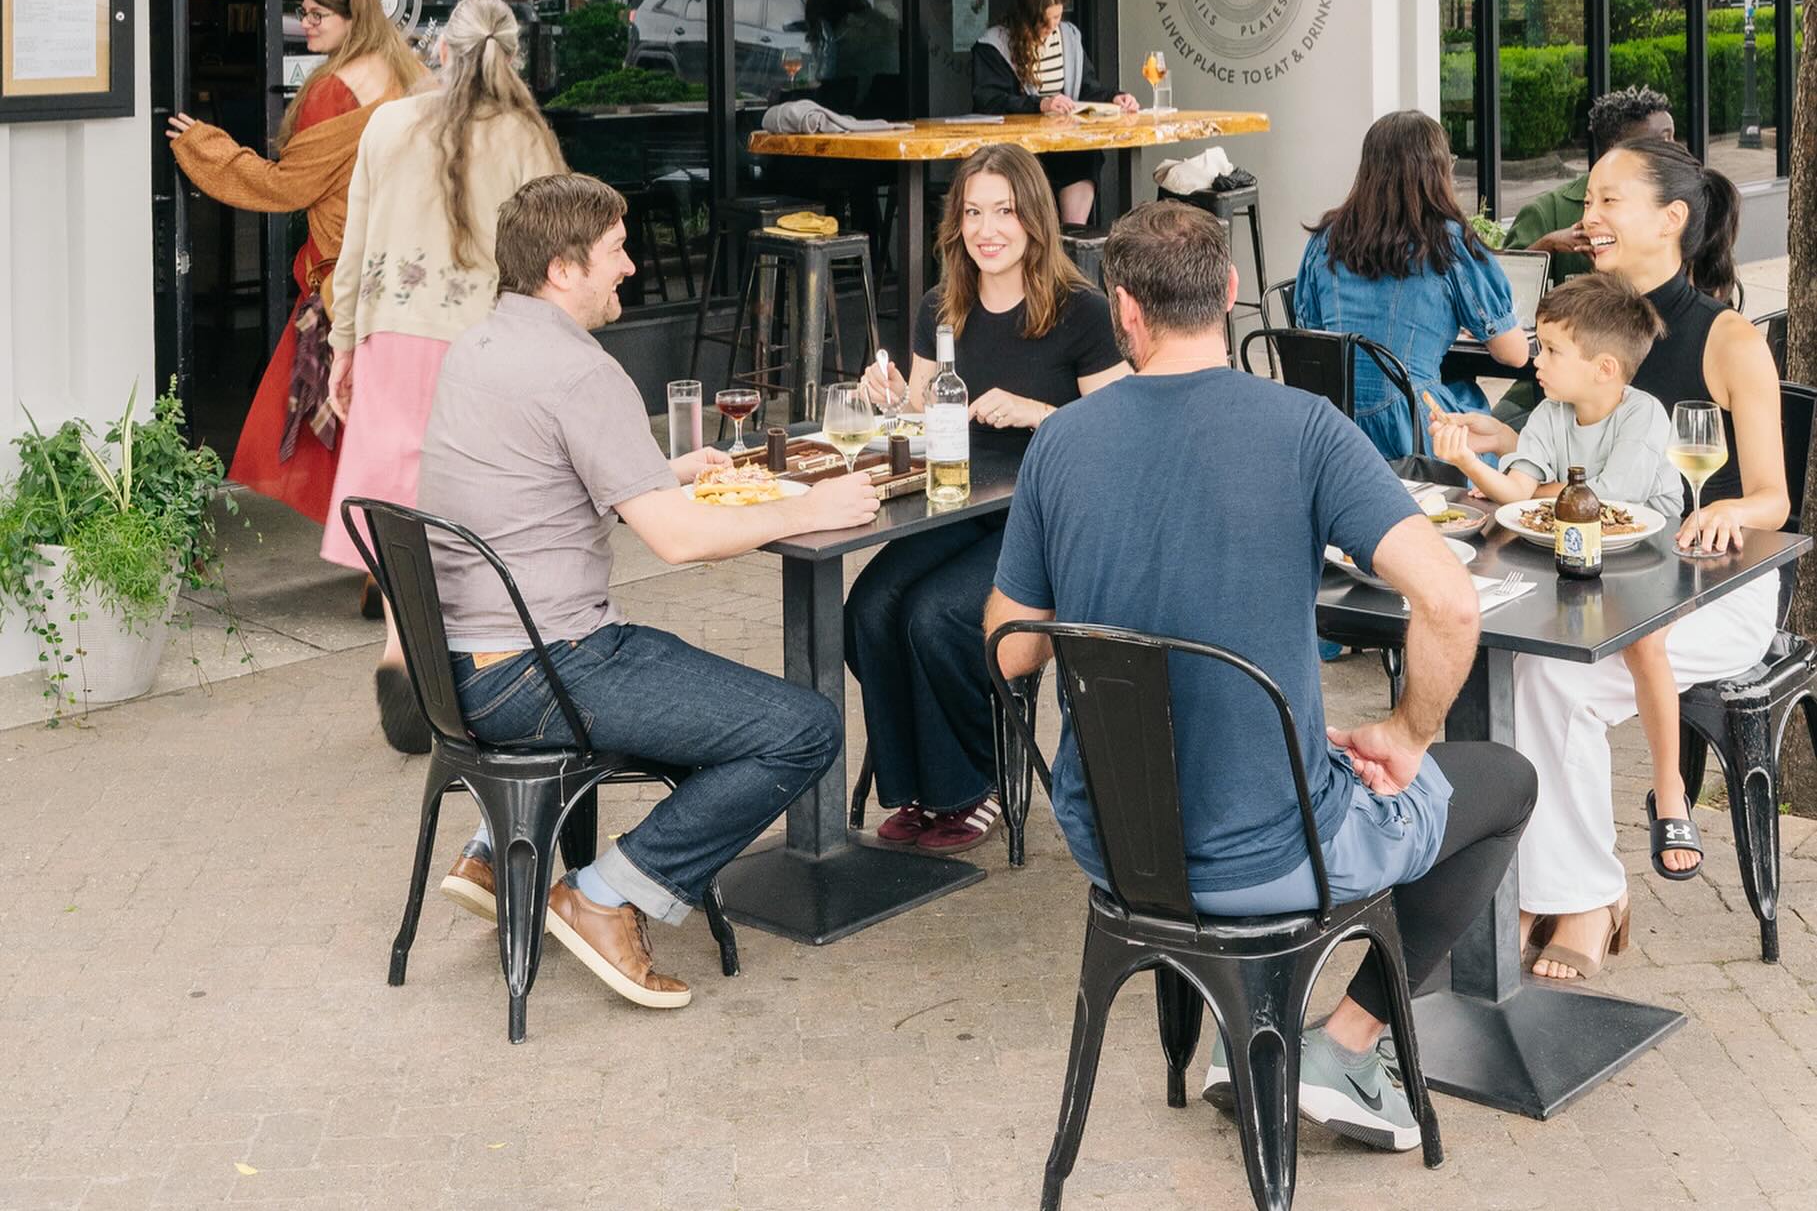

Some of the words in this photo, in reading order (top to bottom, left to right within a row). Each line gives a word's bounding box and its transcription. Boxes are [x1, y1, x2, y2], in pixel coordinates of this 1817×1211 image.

[1155, 0, 1168, 13] A
[1161, 14, 1195, 59] LIVELY
[1291, 50, 1305, 64] &
[1193, 55, 1235, 84] PLACE
[1243, 70, 1262, 85] TO
[1265, 57, 1290, 80] EAT
